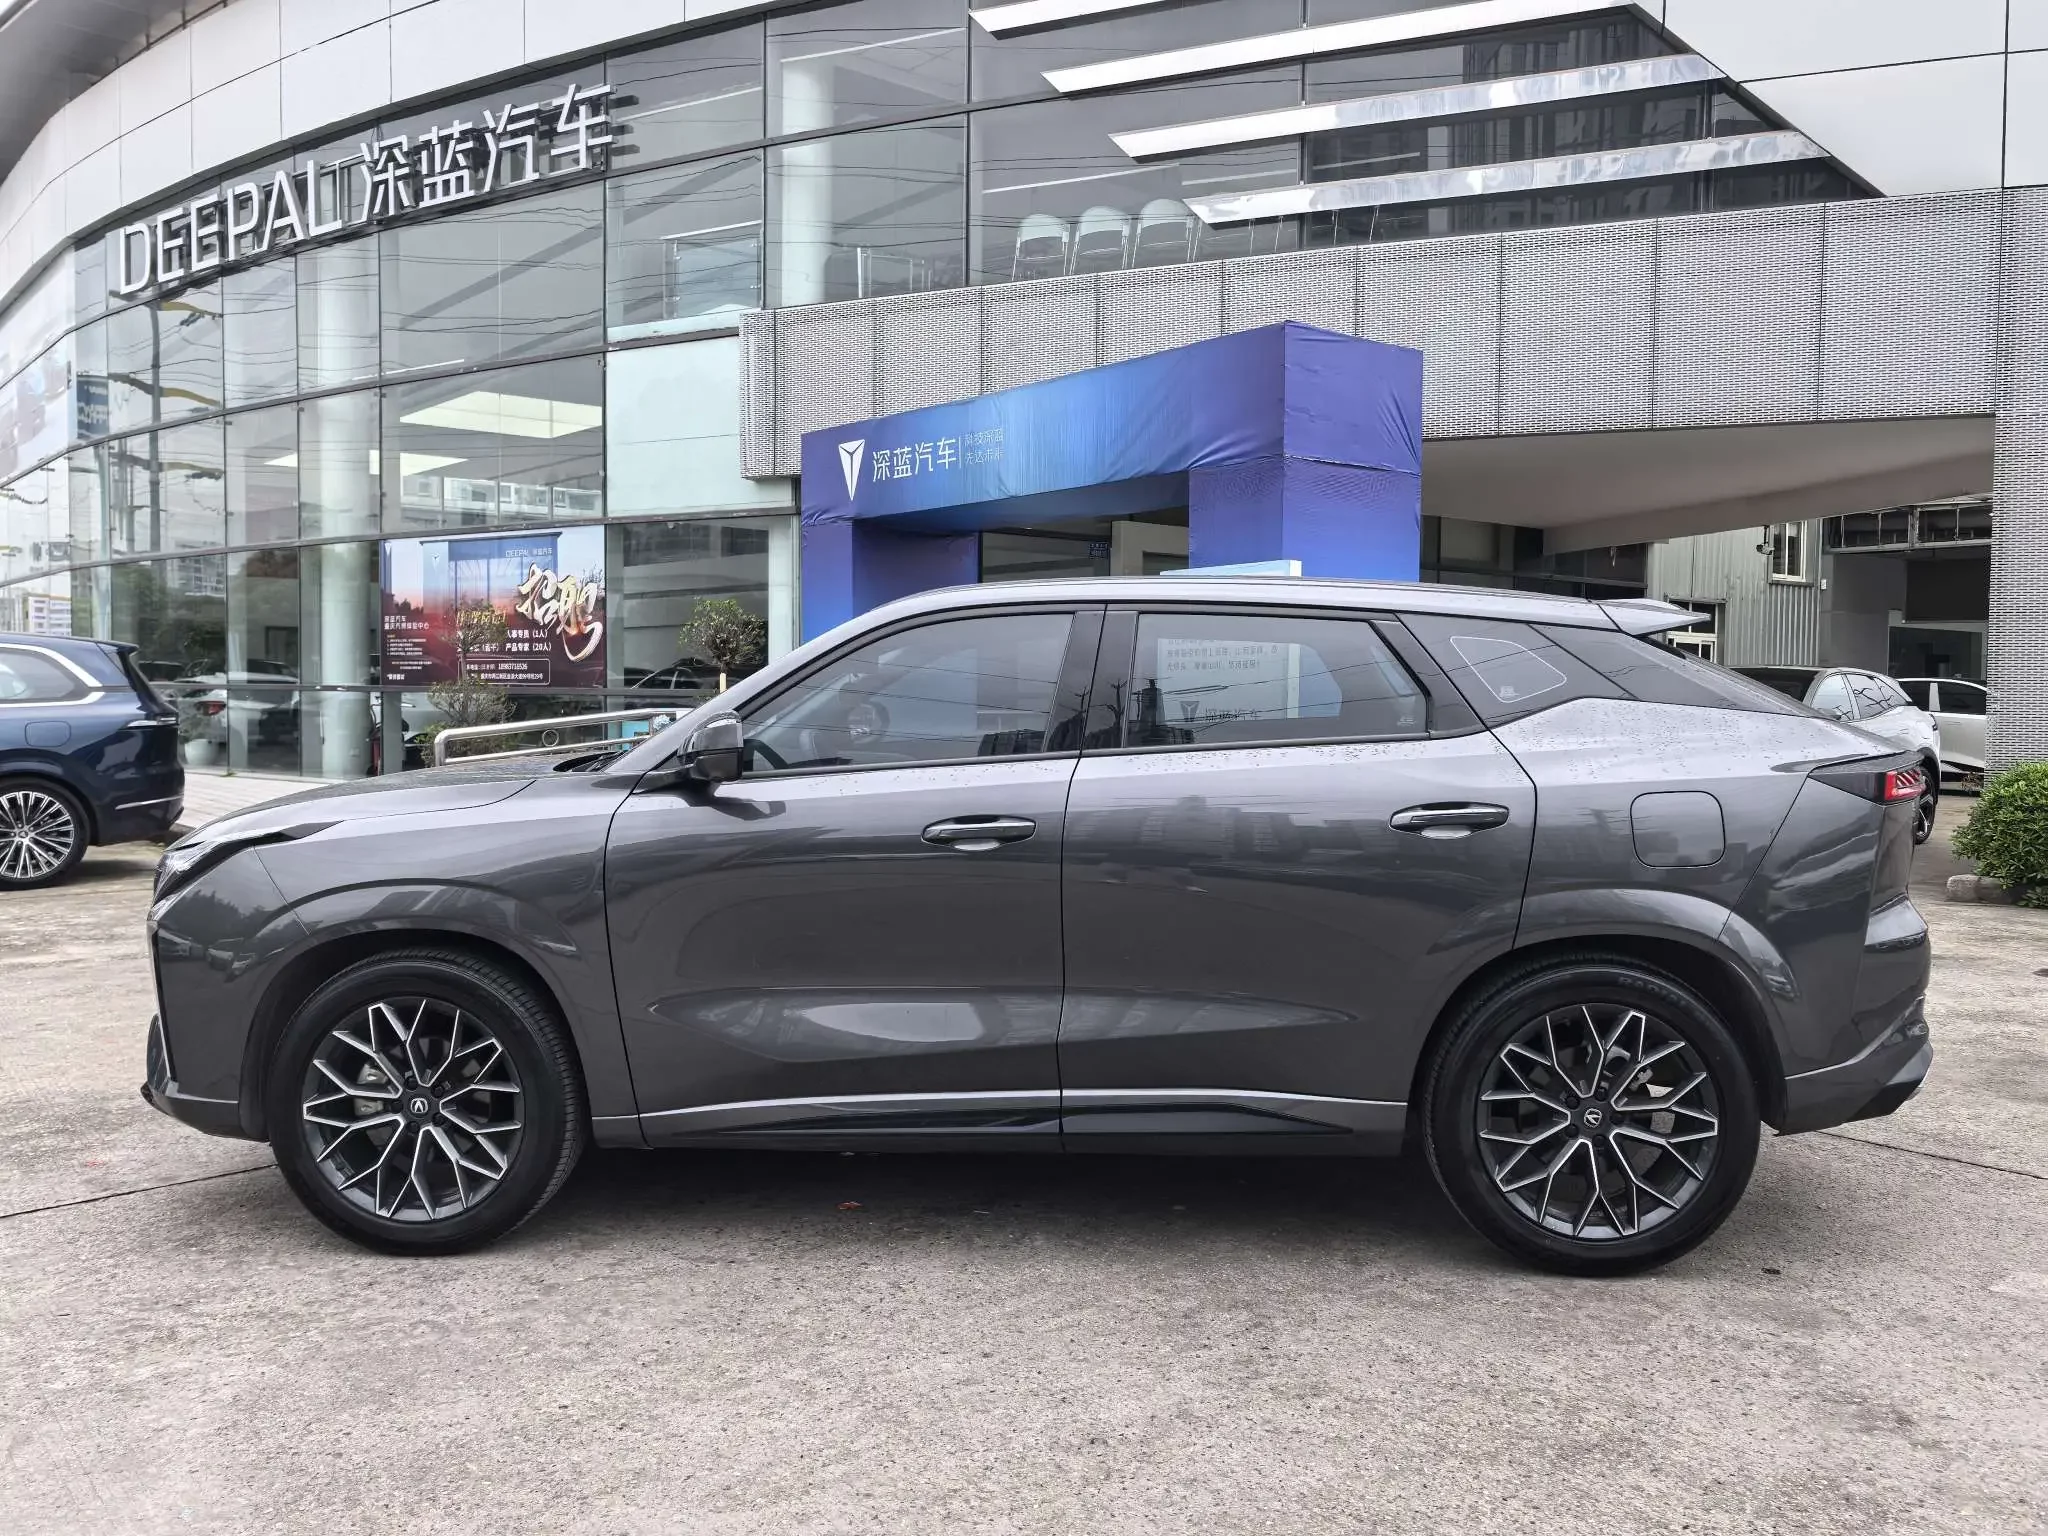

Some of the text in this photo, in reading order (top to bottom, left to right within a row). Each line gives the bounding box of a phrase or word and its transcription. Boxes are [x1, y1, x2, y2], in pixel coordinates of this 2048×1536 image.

[119, 83, 616, 296] DEEPAL 深蓝汽车
[872, 437, 957, 483] 深蓝汽车
